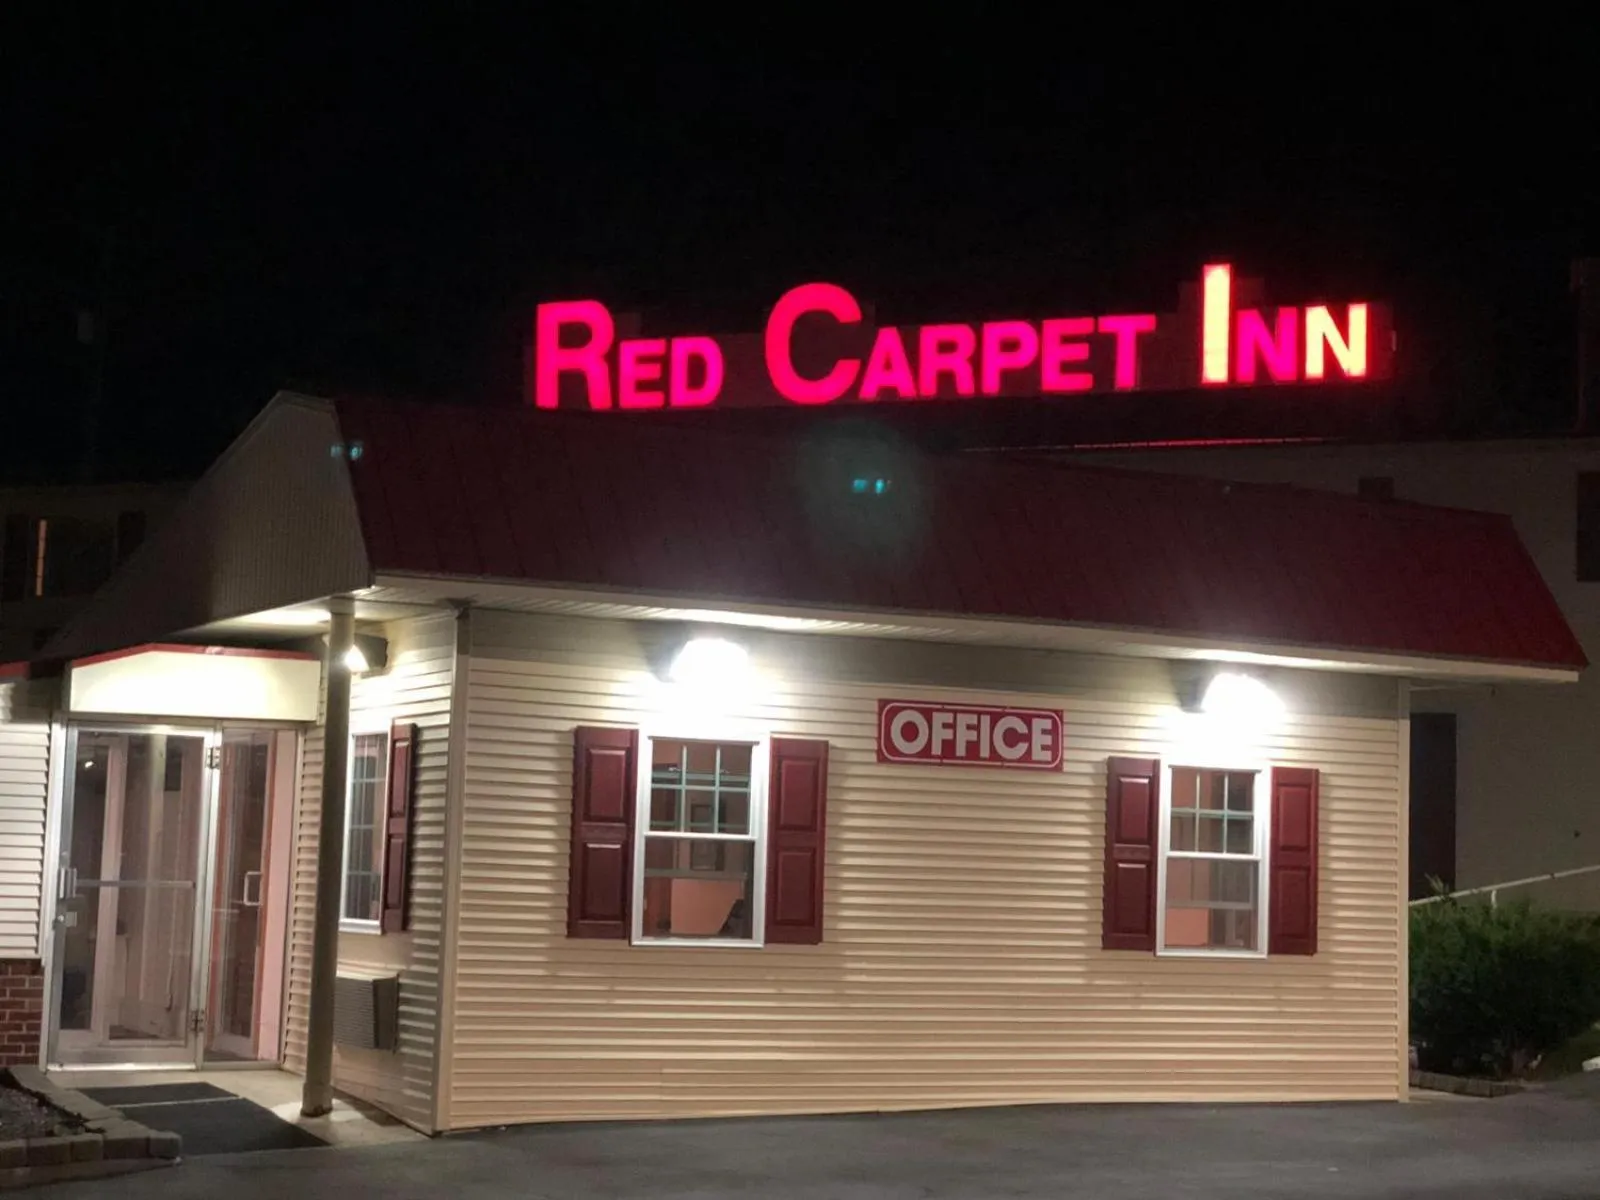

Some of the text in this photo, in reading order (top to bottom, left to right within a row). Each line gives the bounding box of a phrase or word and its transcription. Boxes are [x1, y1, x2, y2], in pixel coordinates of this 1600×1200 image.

[535, 263, 1367, 410] RED CARPET INN
[890, 709, 1053, 762] OFFICE
